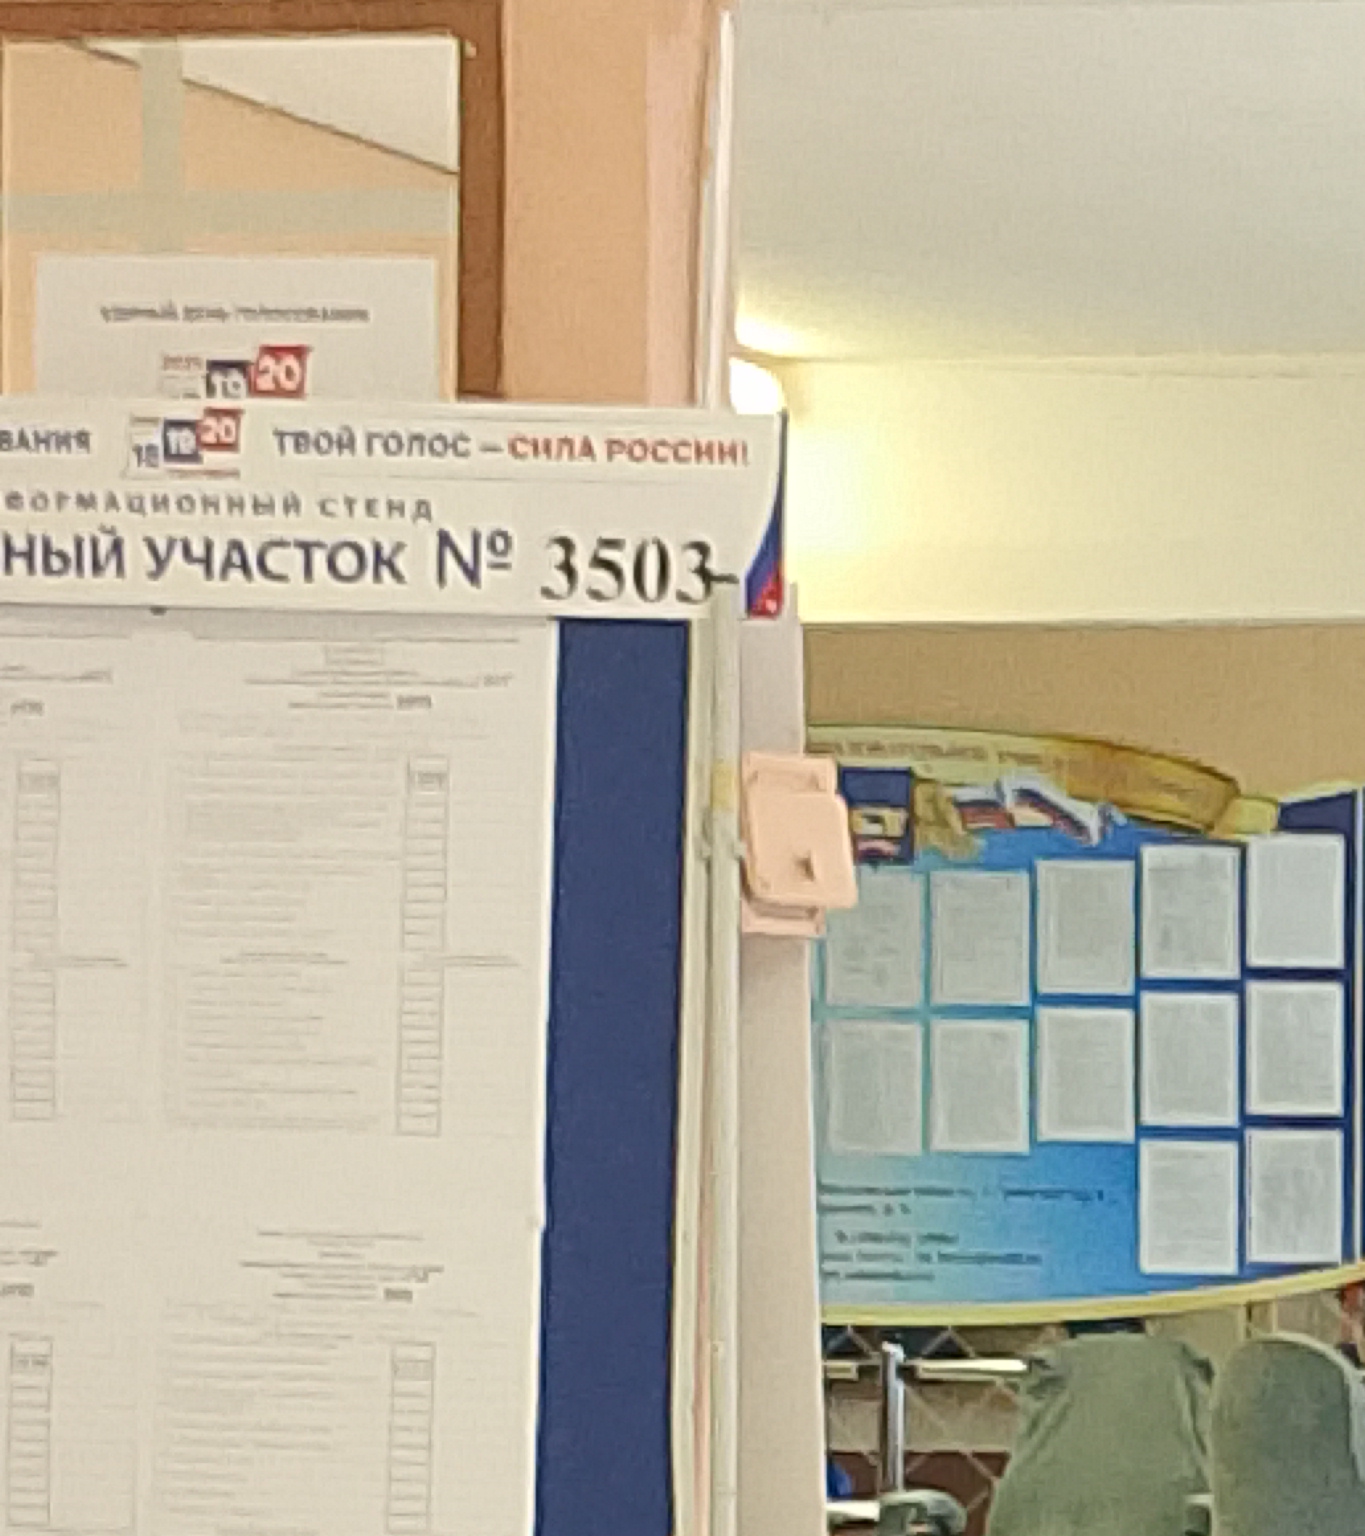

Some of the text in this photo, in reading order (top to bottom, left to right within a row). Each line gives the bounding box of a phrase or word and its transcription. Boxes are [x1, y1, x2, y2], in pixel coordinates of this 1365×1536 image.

[255, 353, 302, 392] 20
[200, 416, 237, 445] 20
[273, 425, 357, 457] ТВОЙ
[366, 430, 472, 459] ГОЛОС
[507, 432, 597, 463] СИЛА
[605, 436, 749, 467] РОССИИ!
[317, 495, 434, 523] СТЕНД
[2, 523, 713, 604] НЫЙ УЧАСТОК № 3503
